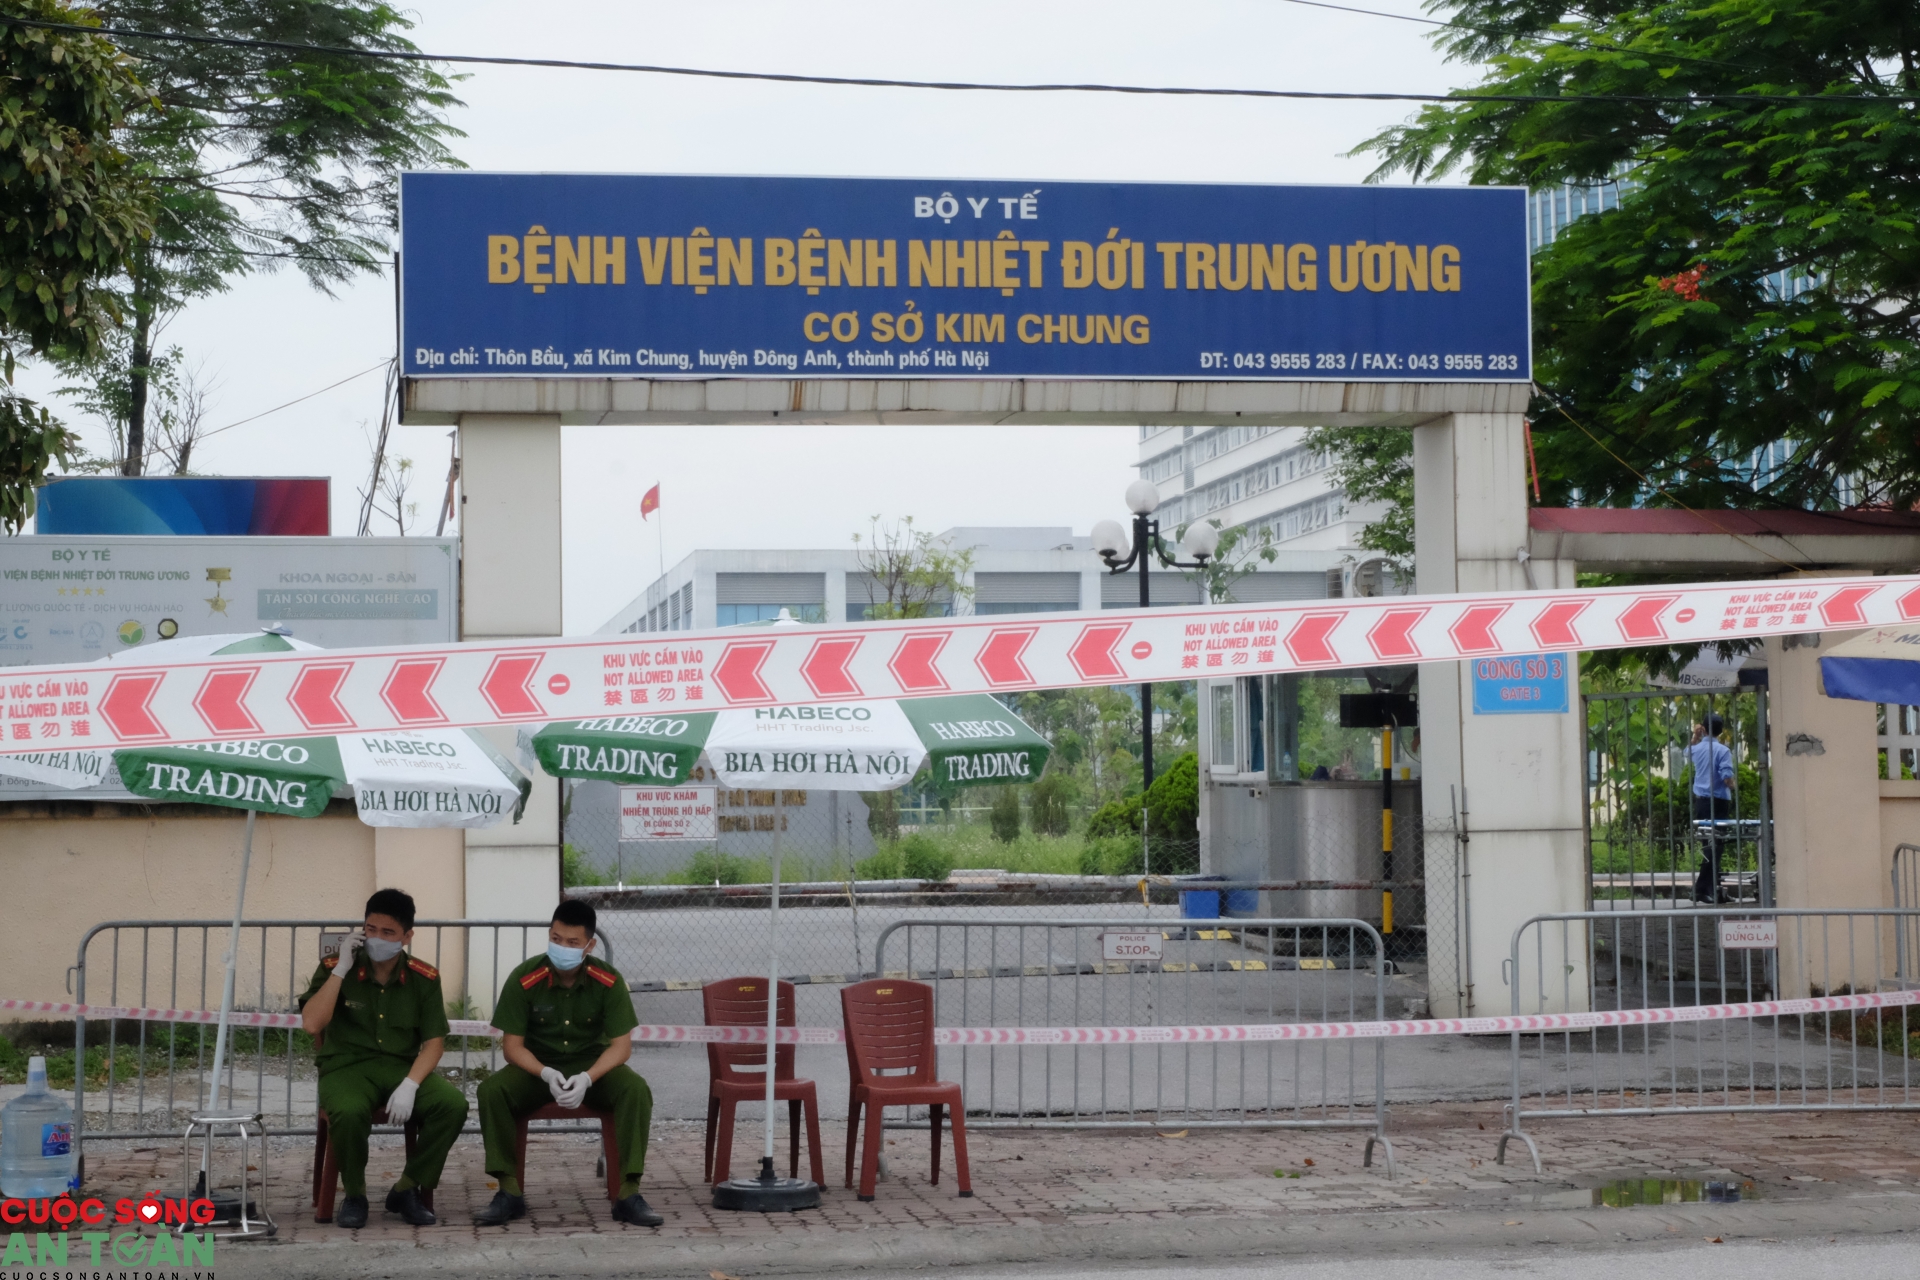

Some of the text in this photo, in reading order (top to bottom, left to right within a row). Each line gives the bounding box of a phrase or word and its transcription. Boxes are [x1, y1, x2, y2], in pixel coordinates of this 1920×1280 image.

[914, 189, 1042, 224] BỘ Y TẾ
[488, 225, 1461, 297] BỆNH VIỆN BỆNH NHIỆT ĐỚI TRUNG ƯƠNG
[804, 300, 1150, 344] CƠ SỞ KIM CHUNG
[416, 347, 1518, 371] Địa chỉ: Thôn Bầu, xã Kim Chung, huyện Đông Anh, thành phố Hà Nội ĐT: 043 9555 283 / FAX: 043 9555 283
[52, 549, 74, 563] BỘ
[78, 550, 88, 561] Y
[4, 568, 28, 582] VIỆN
[31, 568, 60, 582] BỆNH
[63, 568, 94, 582] NHIỆT
[118, 570, 155, 580] TRUNG
[158, 570, 190, 580] ƯƠNG
[280, 572, 322, 584] KHOA
[326, 572, 374, 586] NGOẠI
[404, 594, 432, 604] CAO
[1729, 594, 1750, 604] KHU
[1798, 590, 1818, 600] VÀO
[1724, 602, 1812, 616] NOT ALLOWED AREA
[1185, 623, 1206, 636] KHU
[1233, 617, 1254, 634] CẤM
[1258, 617, 1278, 632] VÀO
[1184, 635, 1276, 652] NOT ALLOWED AREA
[604, 653, 625, 668] KHU
[655, 646, 678, 666] CẤM
[681, 646, 703, 664] VÀO
[1182, 650, 1274, 669] 禁區勿進
[604, 668, 704, 686] NOT ALLOWED AREA
[1552, 659, 1562, 680] 3
[37, 678, 60, 698] CẤM
[65, 678, 88, 696] VÀO
[604, 685, 704, 706] 禁區勿進
[1500, 686, 1541, 701] GATE 3
[8, 703, 57, 719] ALLOWED
[62, 701, 90, 716] AREA
[755, 707, 871, 721] HABECO
[0, 720, 91, 741] 區勿進
[756, 724, 788, 732] HHT
[791, 724, 844, 734] Trading
[929, 720, 1016, 740] HABECO
[362, 738, 456, 757] HABECO
[374, 758, 400, 768] HHT
[402, 758, 444, 770] Trading
[558, 744, 678, 778] TRADING
[724, 748, 910, 780] BIA HƠI HÀ NỘI
[945, 752, 1030, 782] TRADING
[146, 762, 307, 808] TRADING
[361, 786, 502, 819] BIA HƠI HÀ NỘI
[636, 790, 698, 802] KHU VỰC KHÁM
[686, 820, 691, 828] 2
[1756, 933, 1774, 943] LẠI
[1116, 945, 1150, 955] STOP
